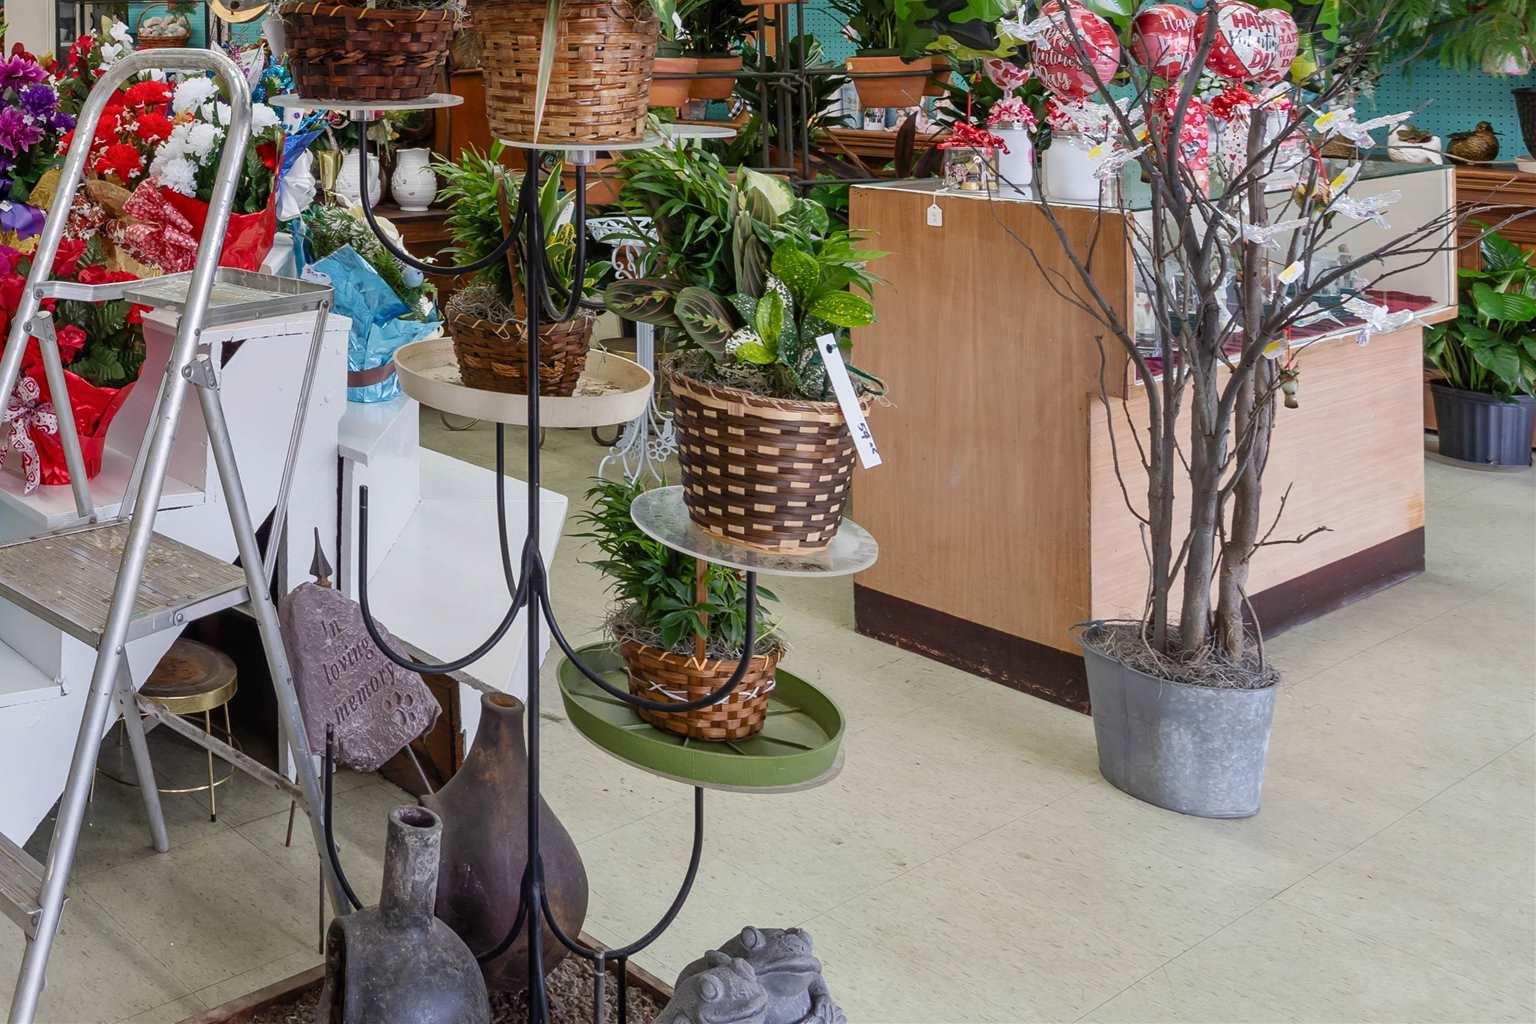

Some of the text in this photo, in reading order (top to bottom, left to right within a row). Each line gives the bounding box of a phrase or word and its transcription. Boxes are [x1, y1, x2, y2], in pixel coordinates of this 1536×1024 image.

[320, 619, 346, 638] In
[323, 637, 375, 686] loving
[334, 662, 397, 725] memory
